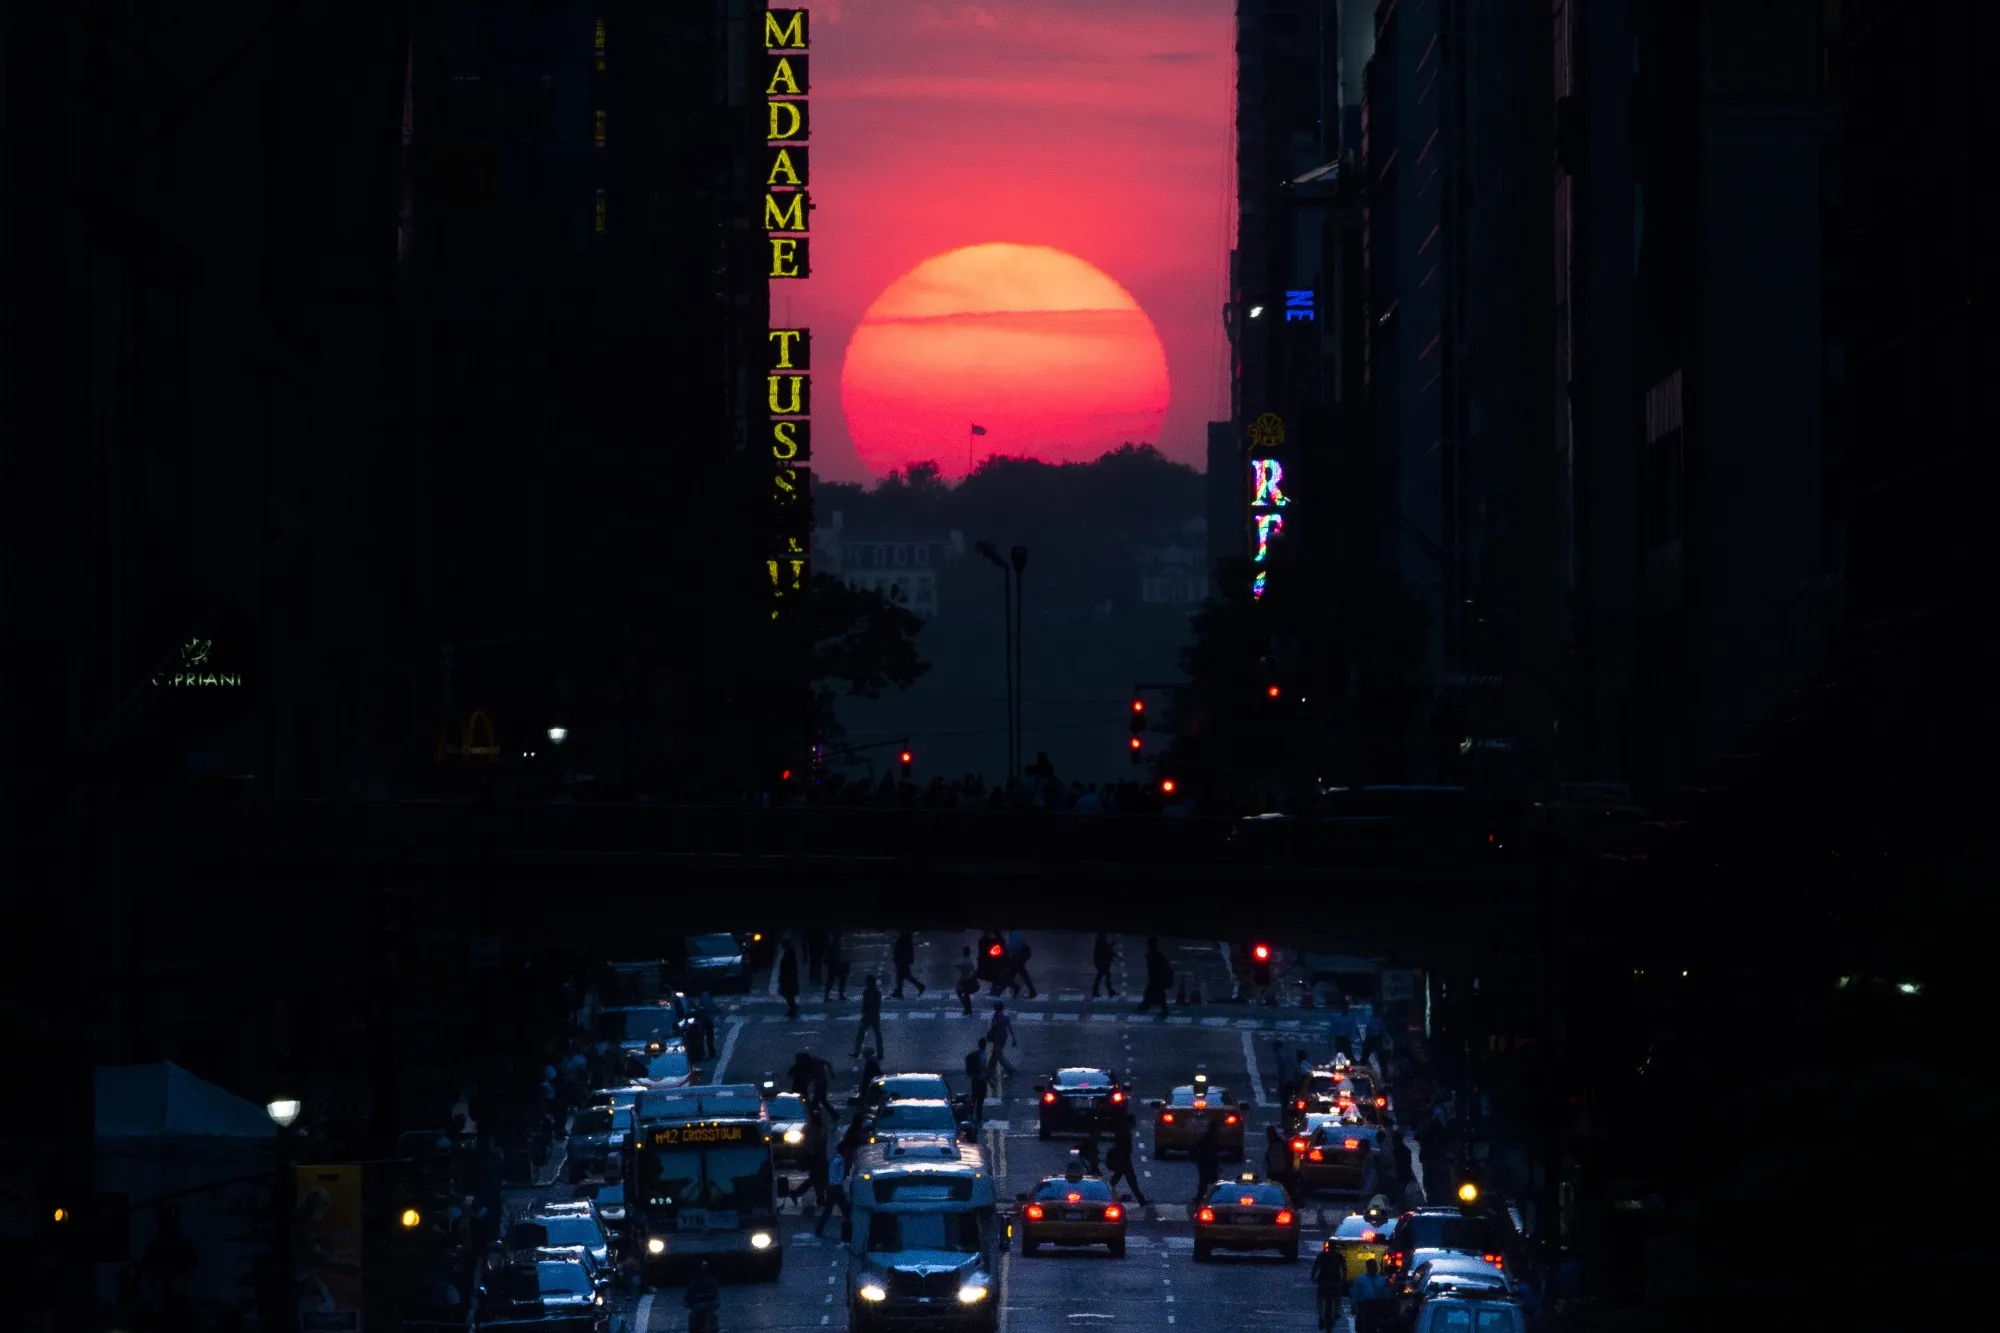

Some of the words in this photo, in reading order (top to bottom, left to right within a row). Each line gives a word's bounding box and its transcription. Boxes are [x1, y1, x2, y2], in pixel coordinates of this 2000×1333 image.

[763, 9, 806, 278] MADAME
[655, 1128, 679, 1145] M42
[682, 1127, 741, 1142] CROSSTOWN
